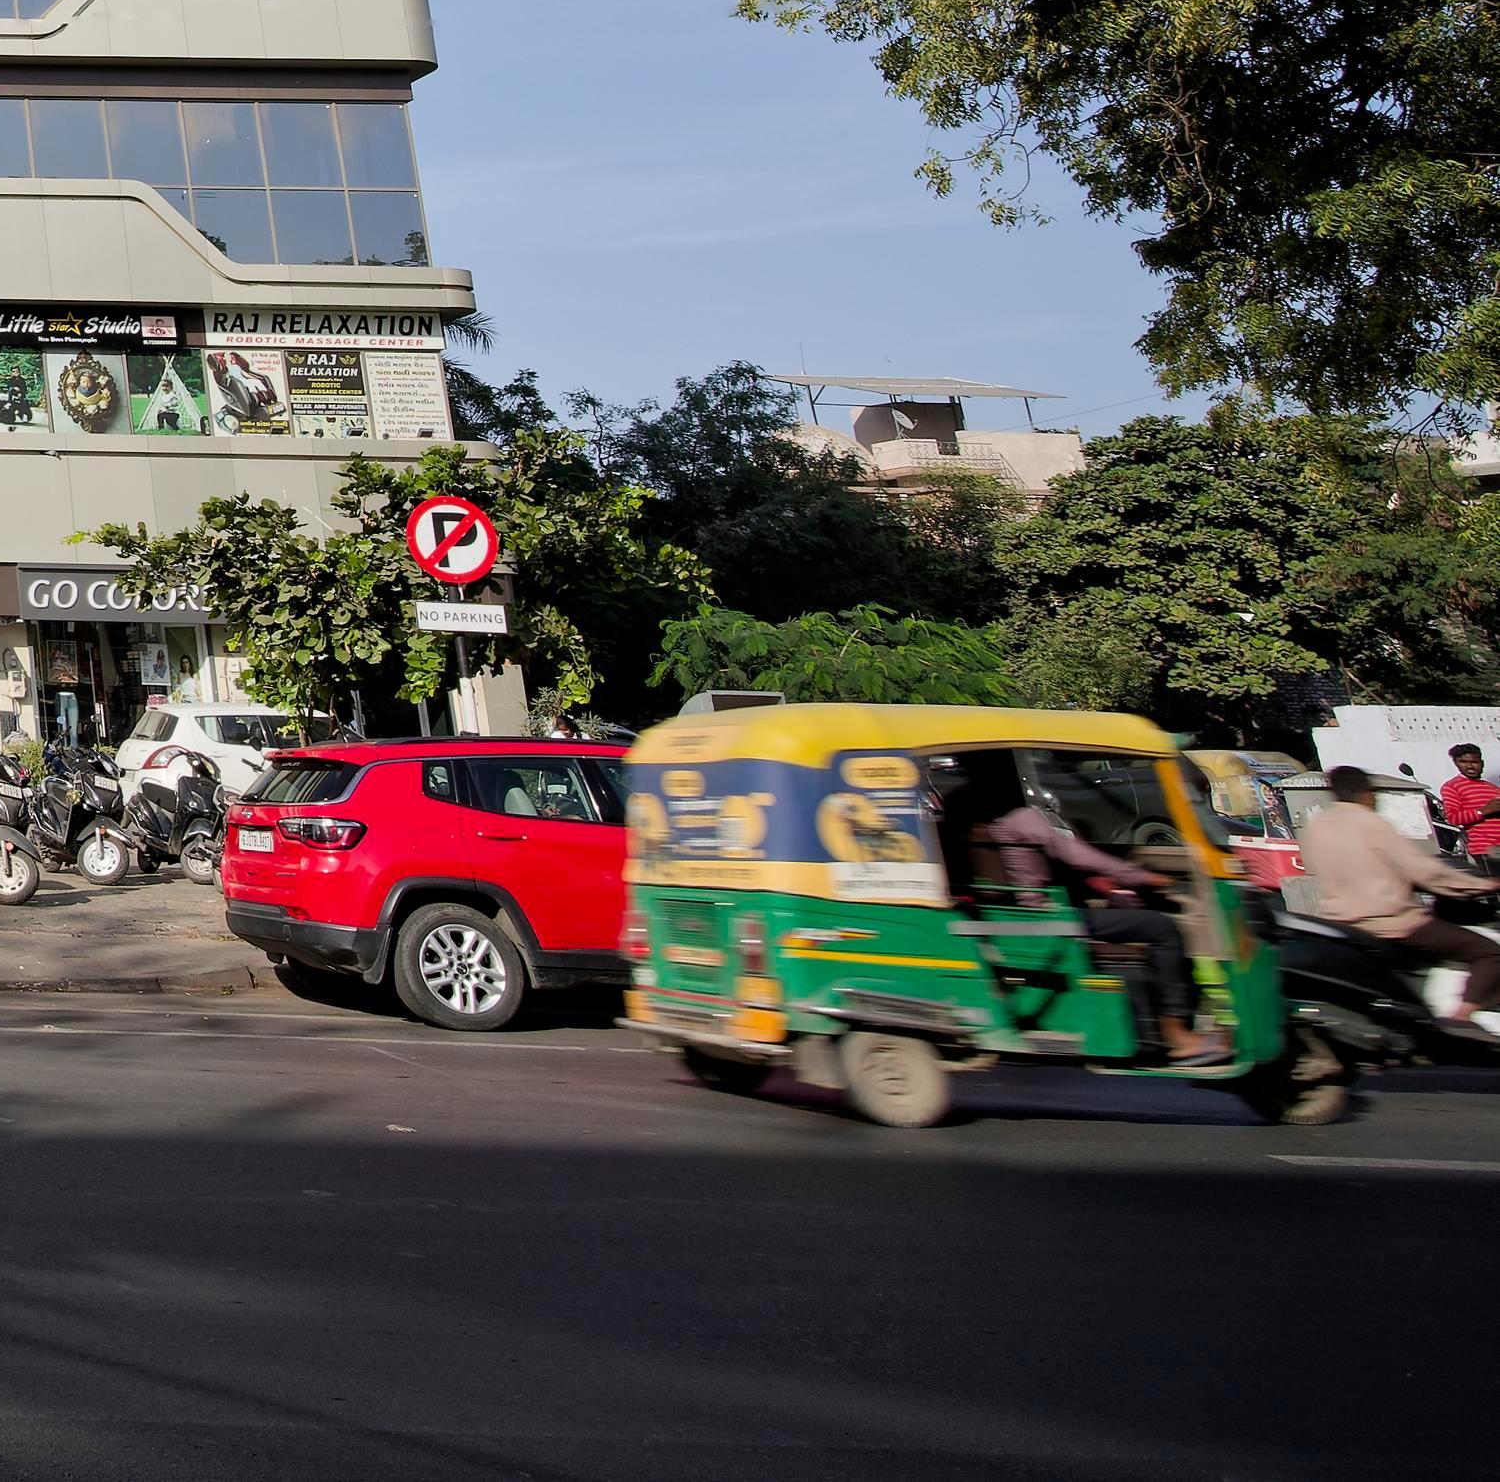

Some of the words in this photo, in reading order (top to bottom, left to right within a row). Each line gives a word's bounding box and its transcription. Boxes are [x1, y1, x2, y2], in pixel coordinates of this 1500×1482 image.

[84, 316, 141, 334] Studio
[212, 312, 260, 333] RAJ
[271, 313, 433, 336] RELAXATION
[226, 336, 287, 344] ROBOTIC
[295, 337, 361, 346] MASSAGE
[369, 338, 425, 347] CENTER
[306, 353, 337, 366] RAJ
[289, 367, 358, 376] RELAXATION
[28, 579, 79, 609] GO
[86, 580, 218, 613] COOR
[419, 610, 439, 621] NO
[443, 611, 504, 624] PARKING
